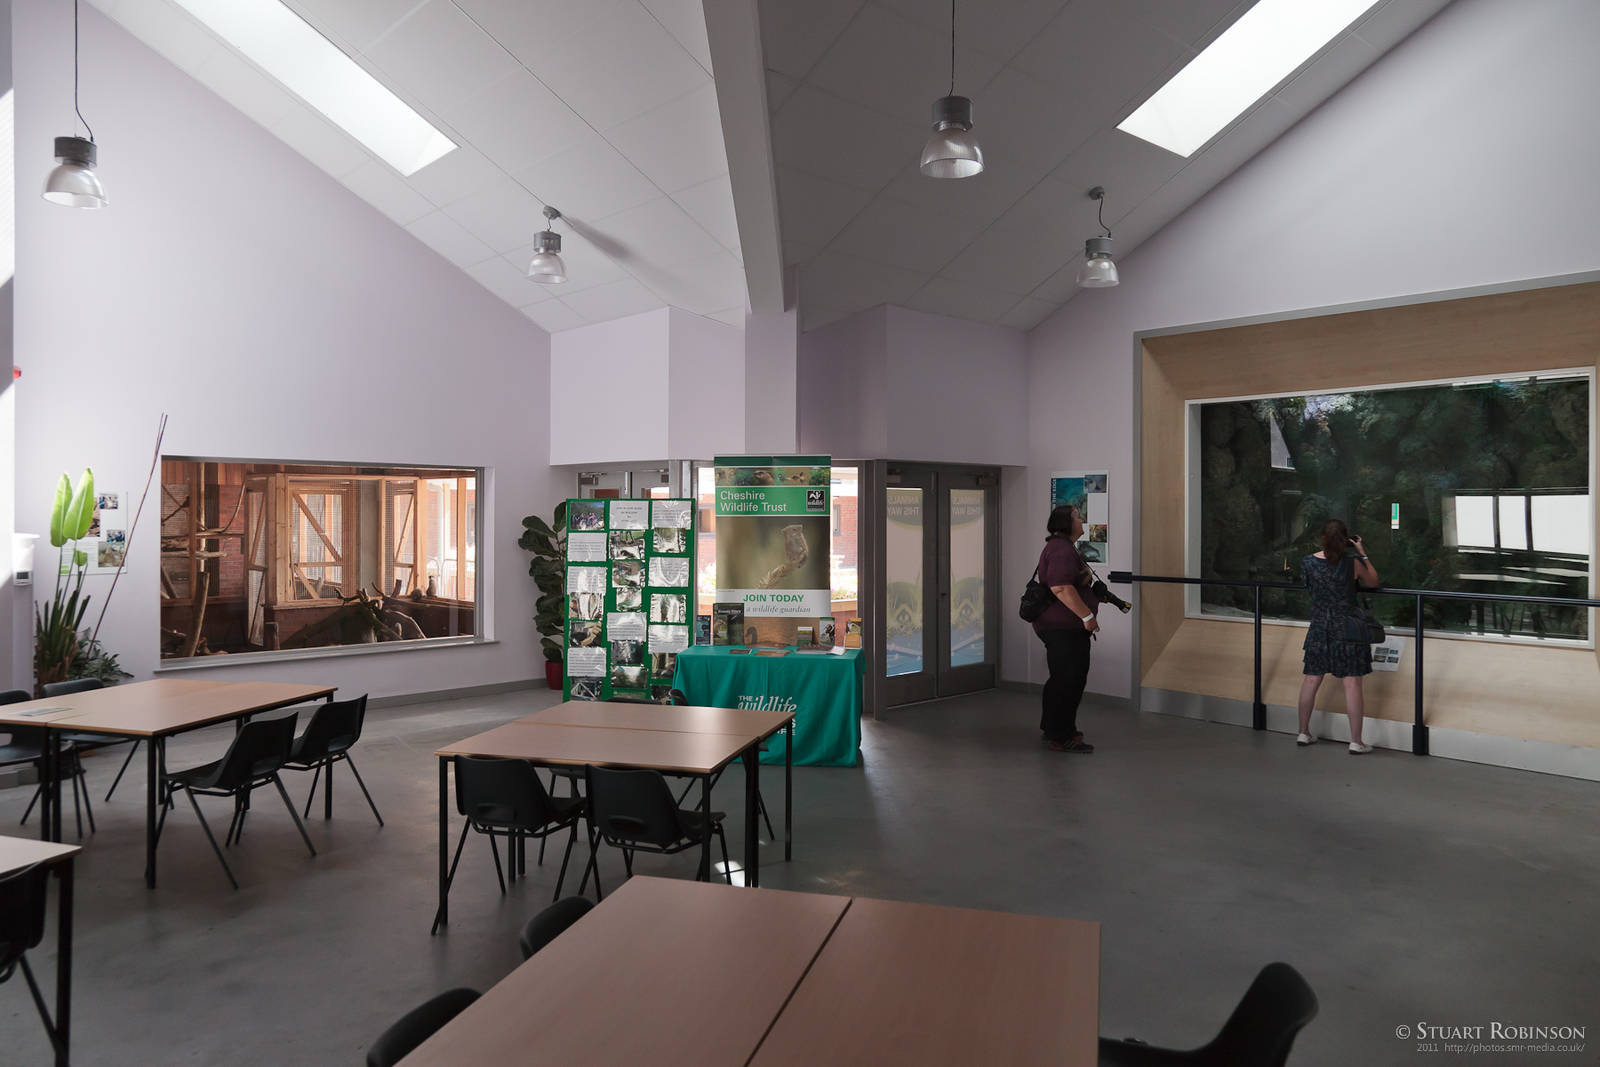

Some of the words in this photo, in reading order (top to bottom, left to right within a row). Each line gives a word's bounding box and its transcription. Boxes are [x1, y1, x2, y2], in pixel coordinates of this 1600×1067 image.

[720, 490, 765, 500] Cheshire
[720, 502, 759, 512] Wildlife
[761, 502, 787, 512] Trust
[743, 594, 767, 602] JOIN
[769, 594, 805, 602] TODAY
[752, 605, 779, 613] wildlife
[780, 606, 811, 614] guardian
[738, 696, 797, 712] wildlife
